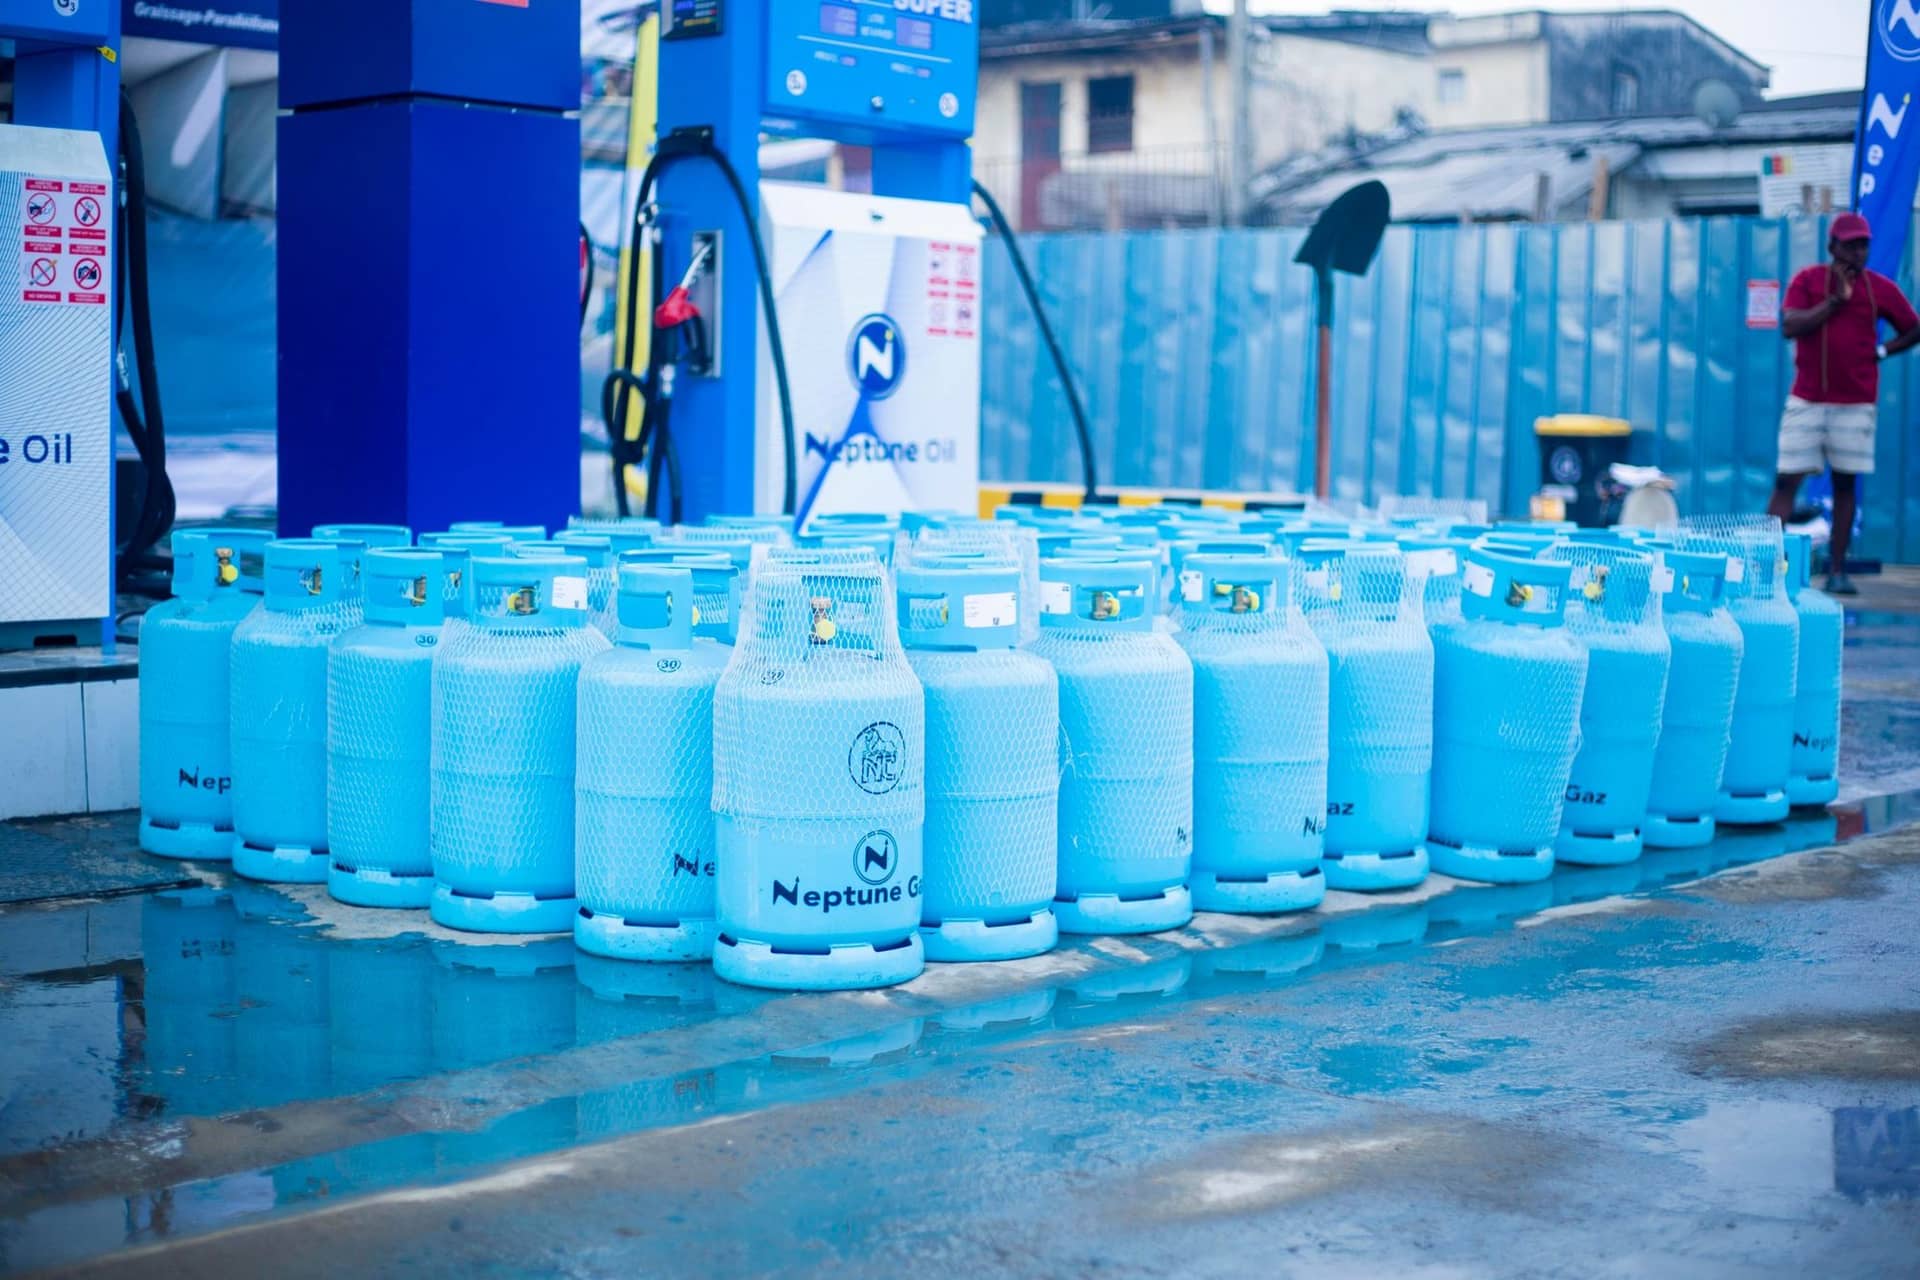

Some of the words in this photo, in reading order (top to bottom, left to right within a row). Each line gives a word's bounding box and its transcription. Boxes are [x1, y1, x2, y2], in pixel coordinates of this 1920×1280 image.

[23, 433, 71, 464] Oil
[805, 431, 917, 468] Neptune
[1565, 784, 1606, 805] Gaz
[772, 876, 901, 913] Neptune
